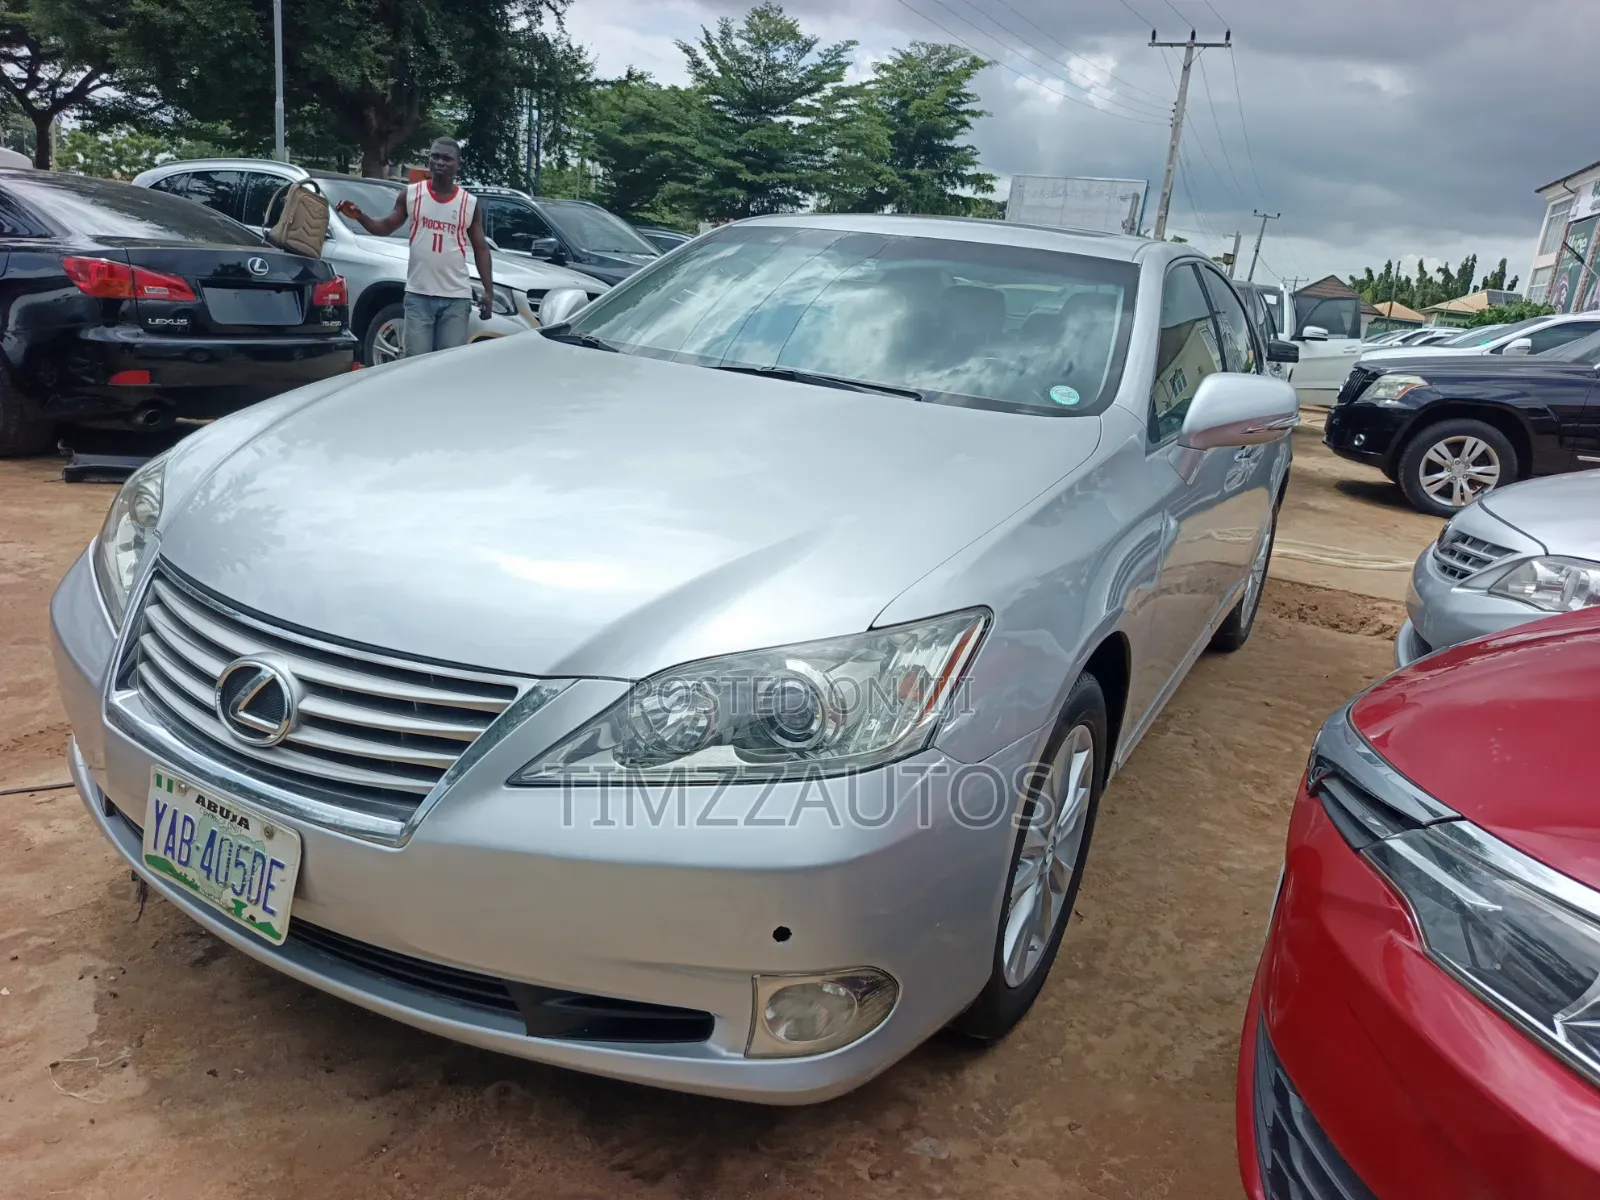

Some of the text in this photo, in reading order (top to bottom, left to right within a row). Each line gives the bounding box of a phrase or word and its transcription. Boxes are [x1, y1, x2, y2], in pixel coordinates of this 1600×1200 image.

[423, 216, 456, 235] ROCKETS
[432, 233, 443, 253] 11
[148, 318, 188, 326] LEXUS
[195, 794, 250, 830] ABUJA
